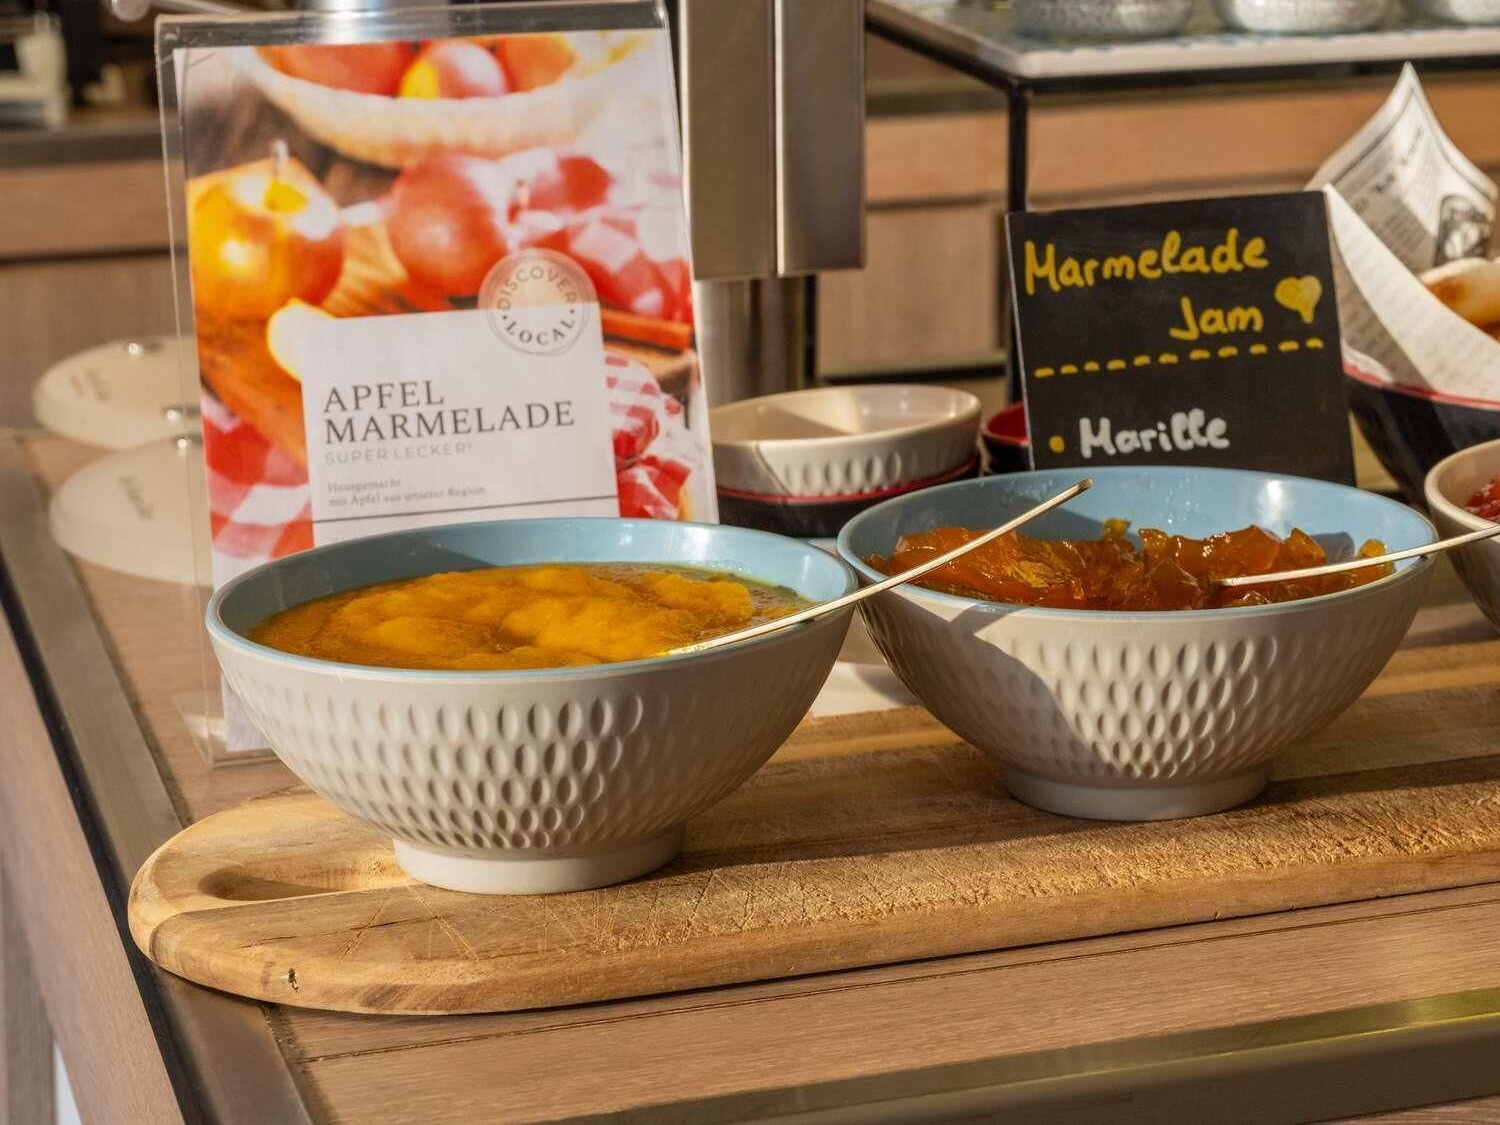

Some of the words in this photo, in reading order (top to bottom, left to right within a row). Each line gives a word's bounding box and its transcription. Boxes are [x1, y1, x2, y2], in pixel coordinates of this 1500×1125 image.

[1024, 228, 1269, 295] Marmelade
[496, 265, 577, 311] DISCOVER
[505, 320, 576, 347] LOCAL
[1169, 296, 1264, 341] Jam
[323, 380, 445, 413] APFEL
[325, 400, 575, 444] MARMELADE
[1078, 407, 1231, 459] Marille
[325, 448, 387, 465] SUPER
